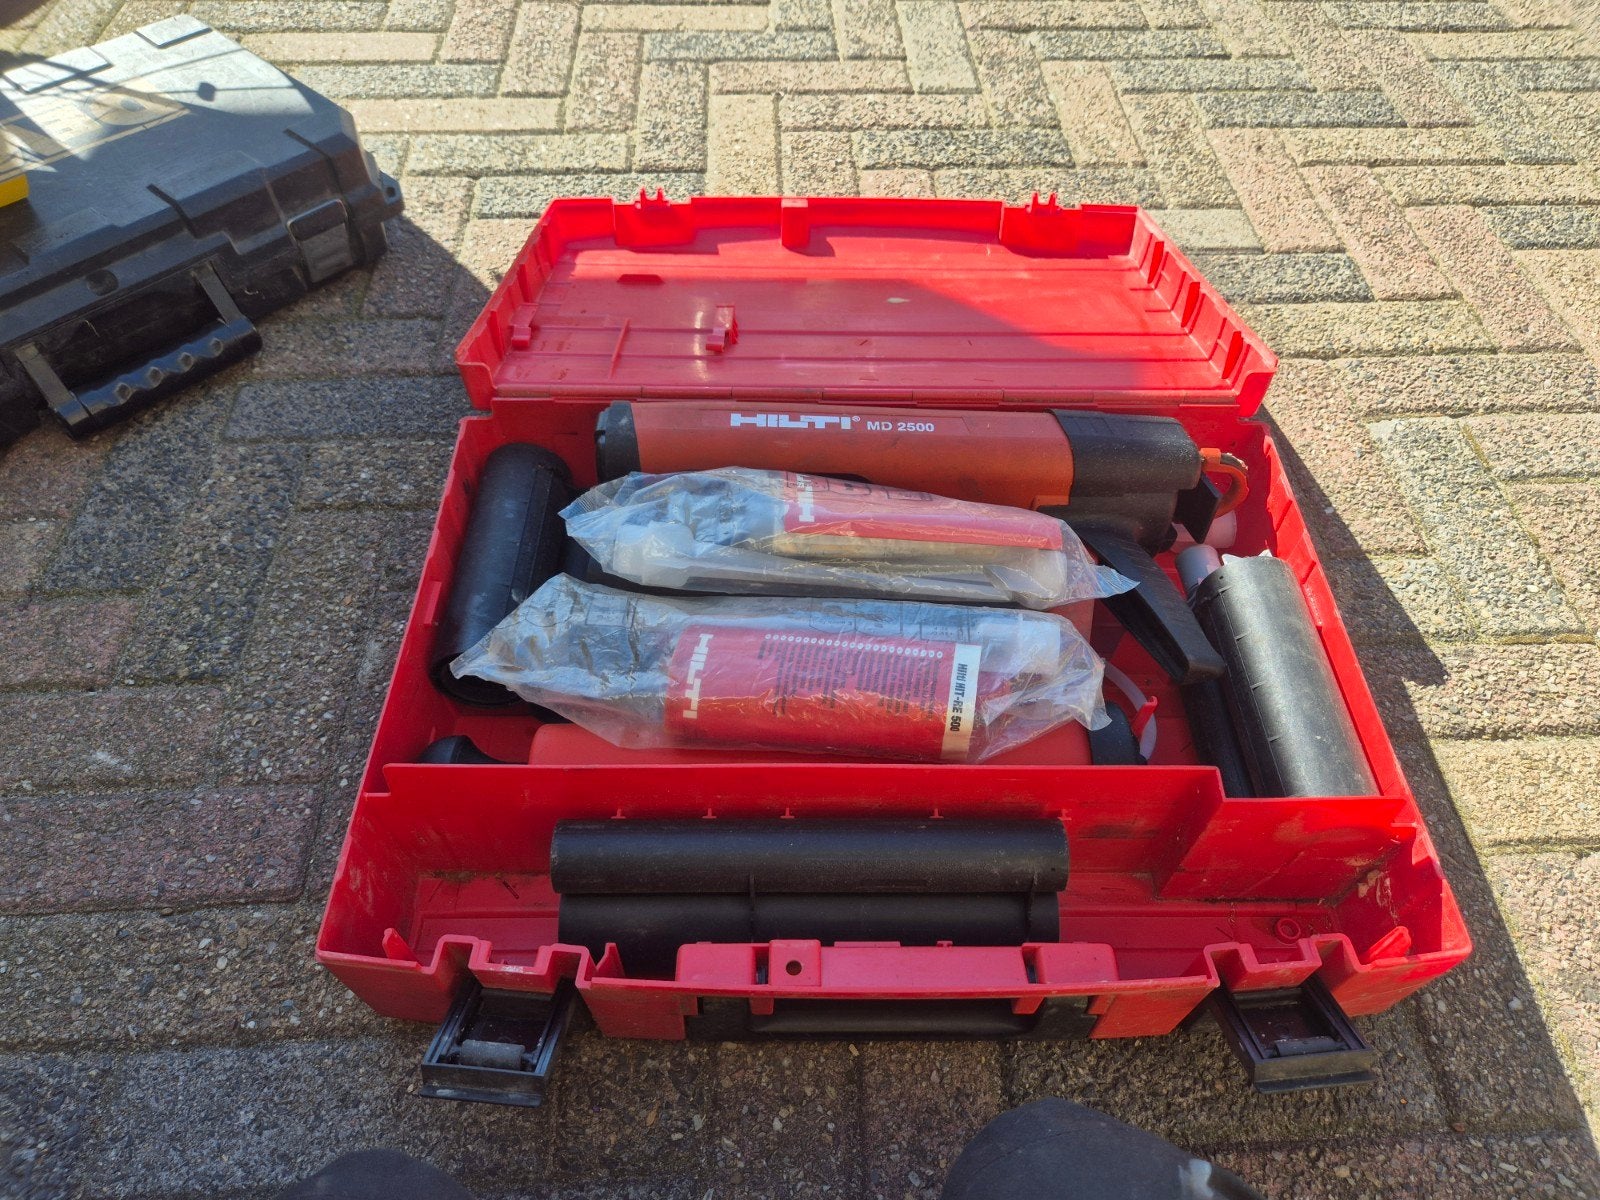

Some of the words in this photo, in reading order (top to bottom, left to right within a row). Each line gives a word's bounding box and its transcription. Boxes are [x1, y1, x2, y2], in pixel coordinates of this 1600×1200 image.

[866, 421, 893, 431] MD
[897, 422, 935, 432] 2500
[682, 633, 714, 719] HILTI
[952, 682, 966, 714] HIT-RE
[950, 715, 962, 732] 500
